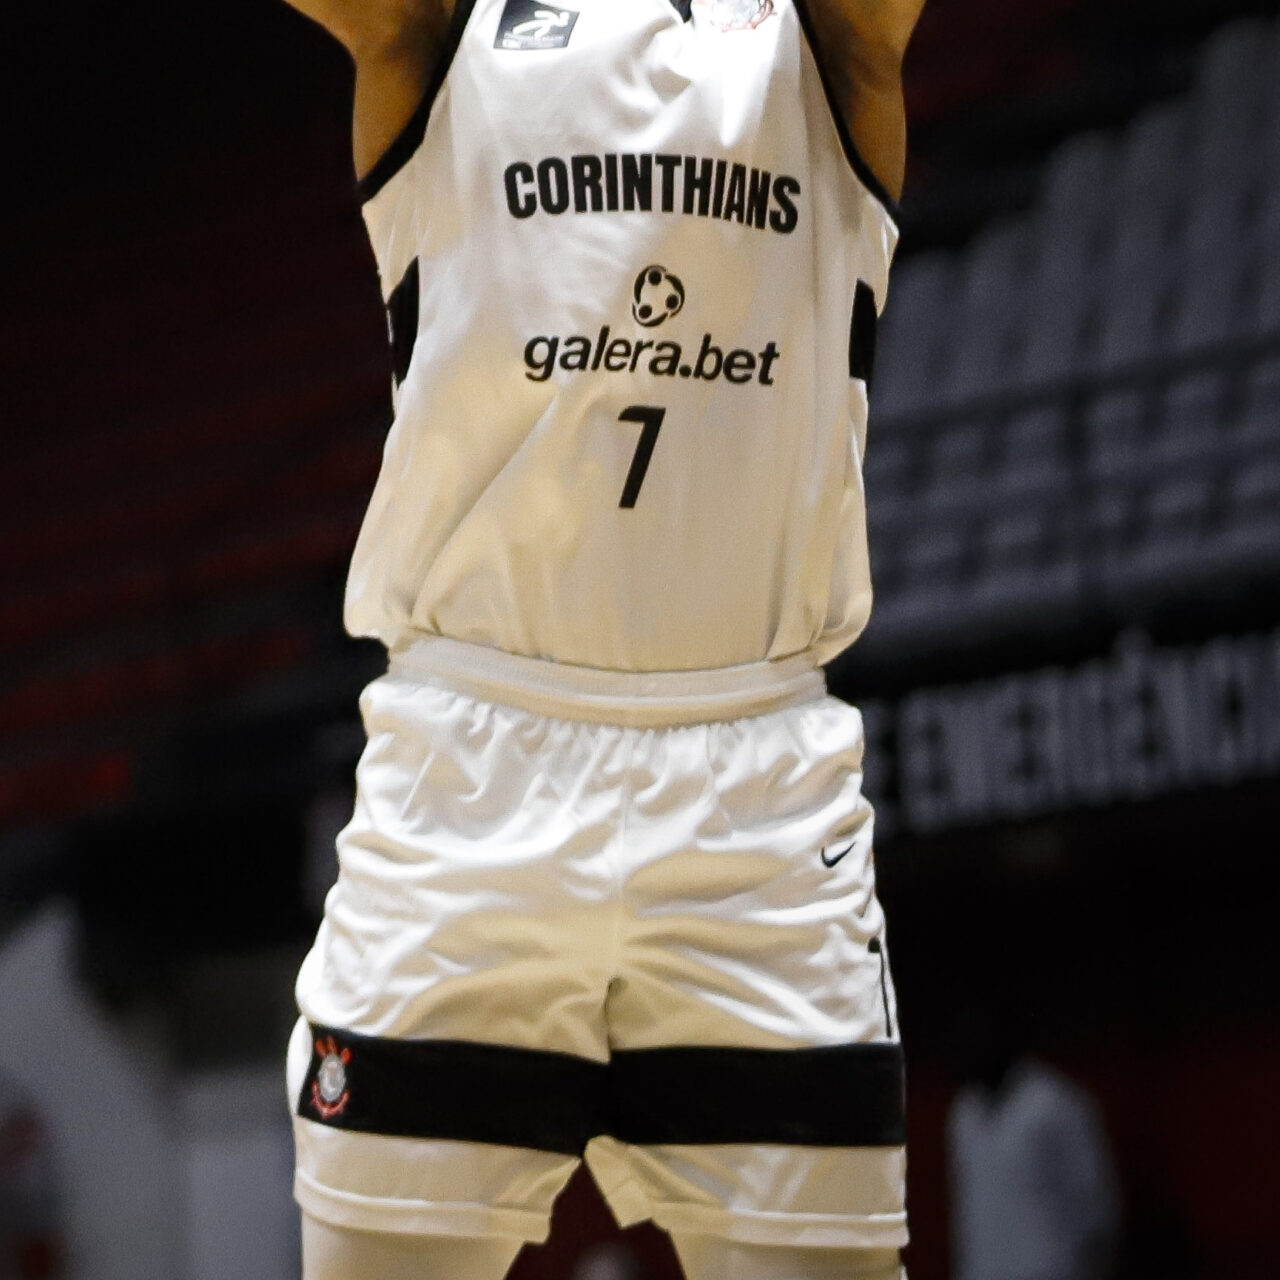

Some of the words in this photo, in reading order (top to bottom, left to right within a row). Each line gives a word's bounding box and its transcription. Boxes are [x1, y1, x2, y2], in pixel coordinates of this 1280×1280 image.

[504, 152, 801, 234] CORINTHIANS
[524, 324, 780, 387] galera.bet
[617, 405, 666, 509] 7
